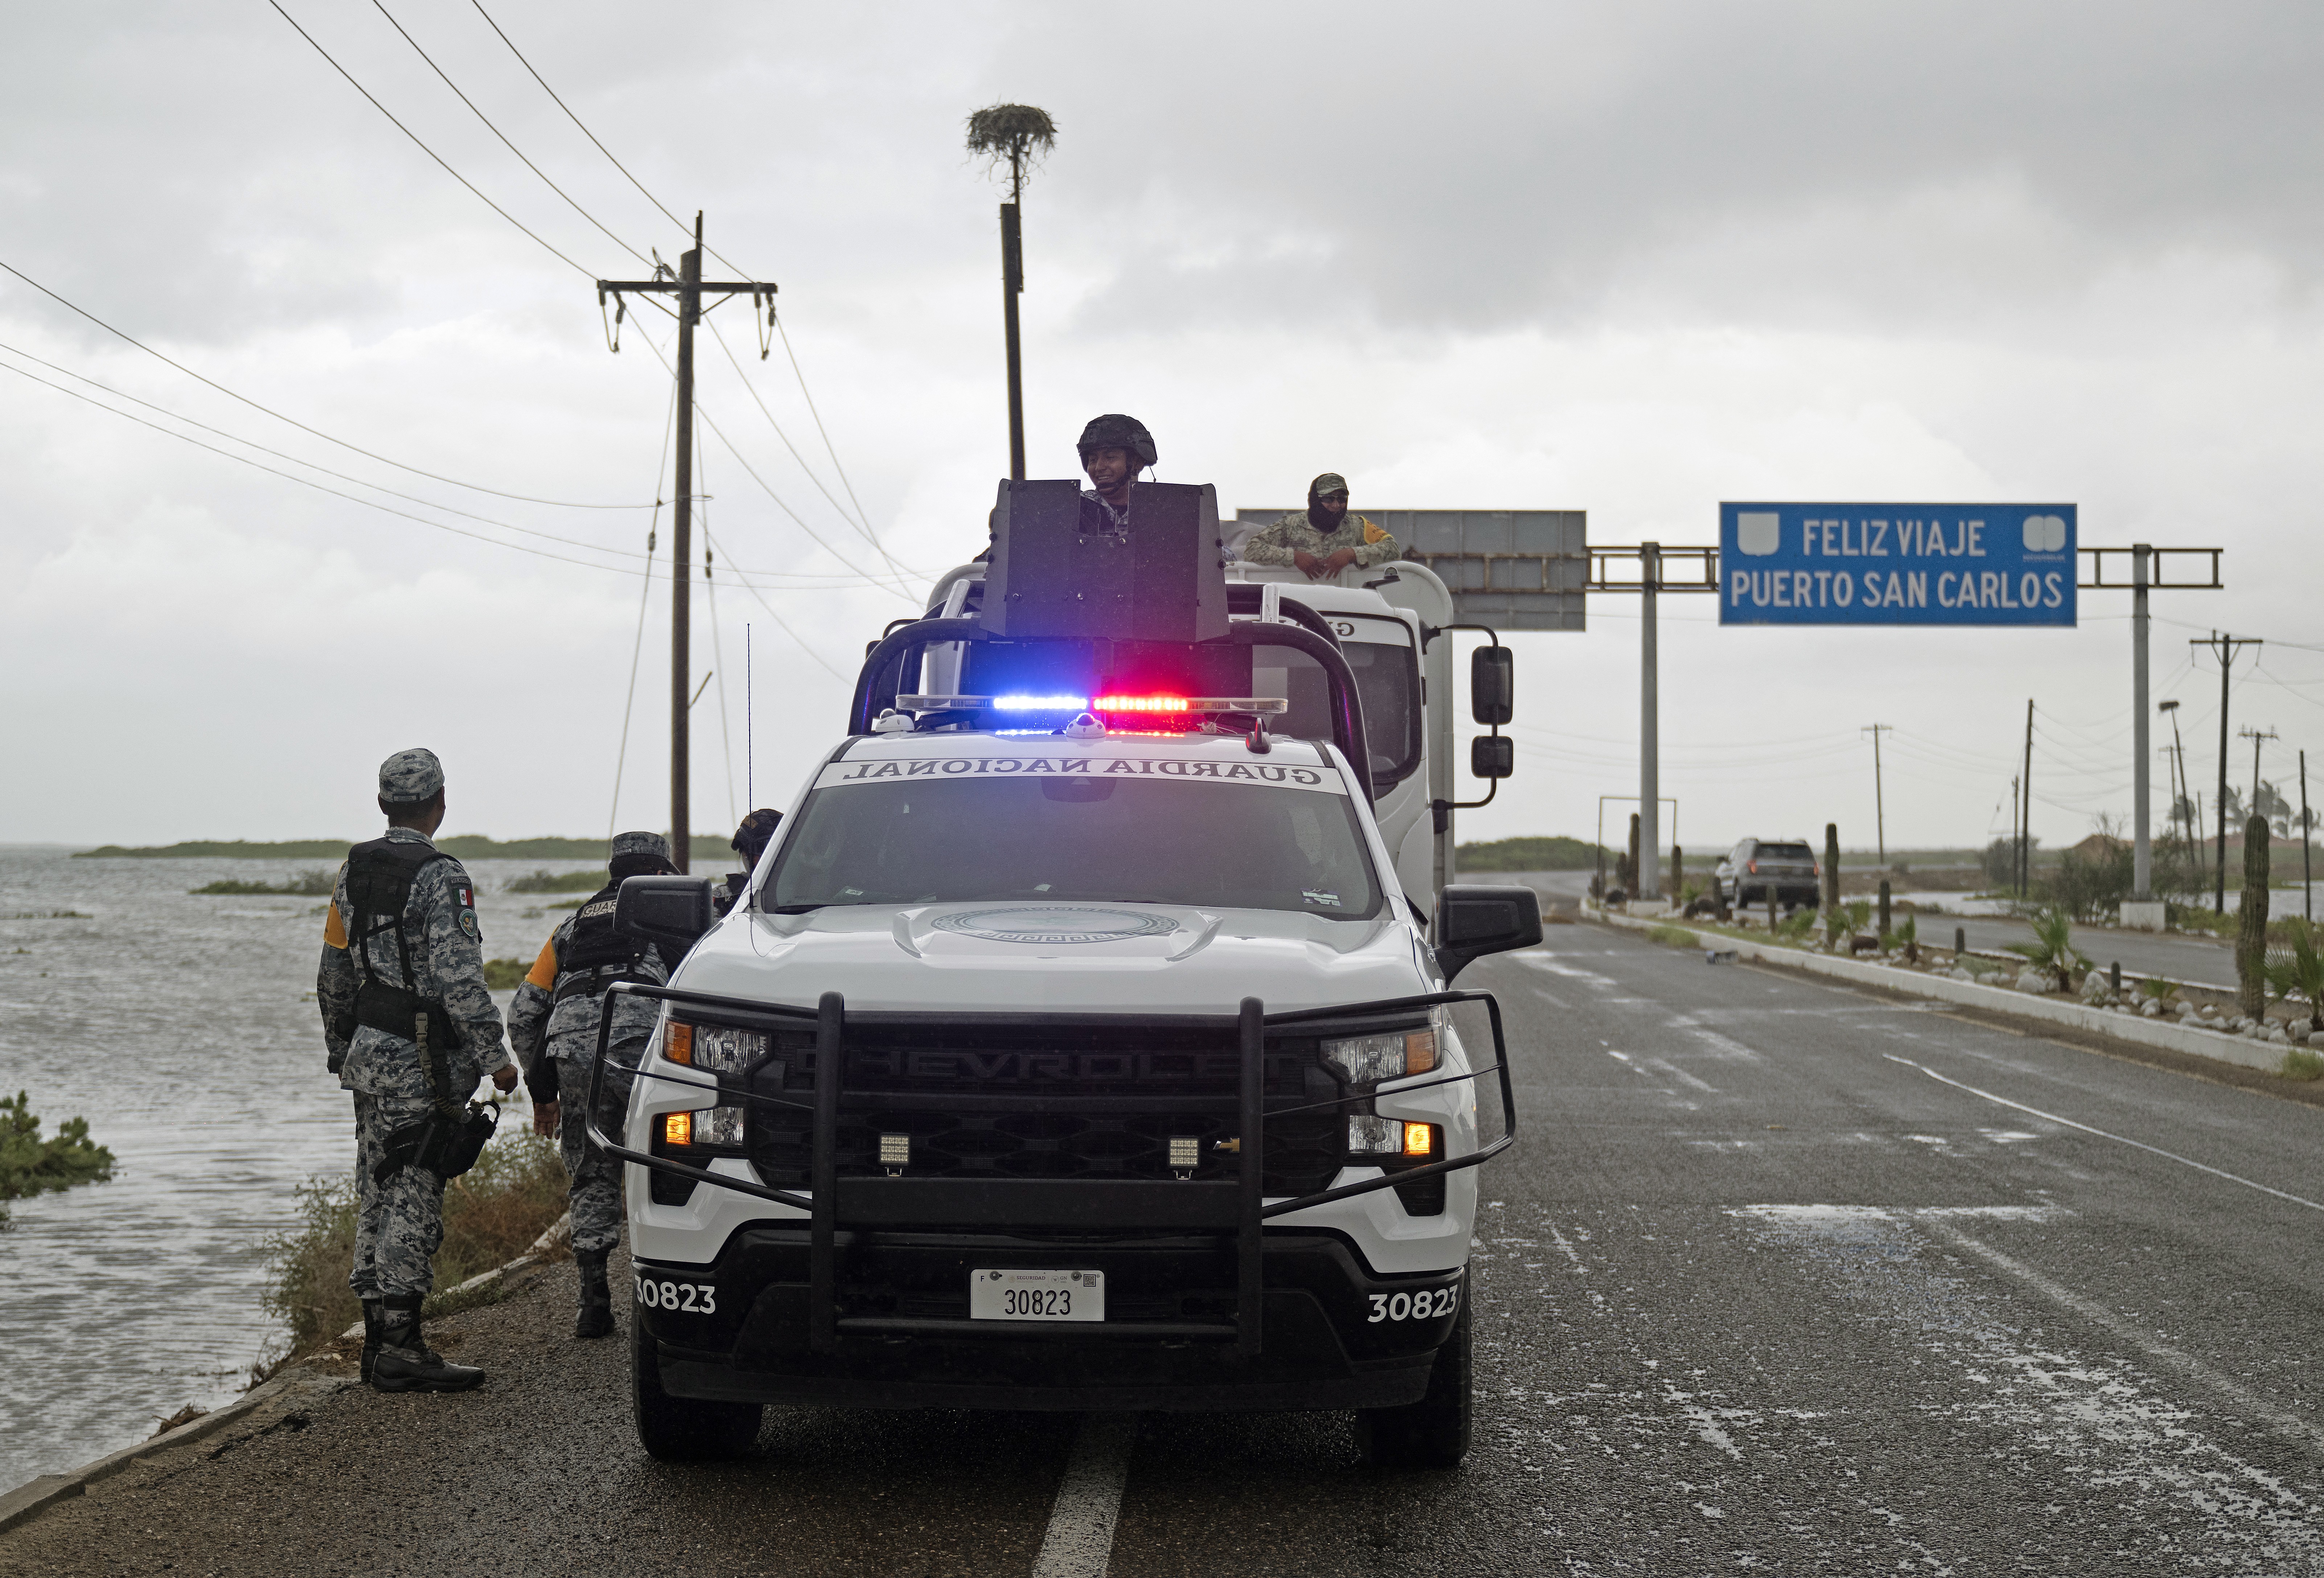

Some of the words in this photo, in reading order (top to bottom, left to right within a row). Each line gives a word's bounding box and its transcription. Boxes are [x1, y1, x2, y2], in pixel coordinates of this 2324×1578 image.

[1803, 520, 1888, 556] FELIZ
[1896, 520, 1986, 556] VIAJE
[1731, 571, 1853, 607] PUERTO
[1862, 571, 1926, 607] SAN
[1938, 571, 2063, 608] CARLOS
[635, 1274, 716, 1314] 30823
[1005, 1289, 1071, 1315] 30823
[1367, 1284, 1458, 1323] 30823
